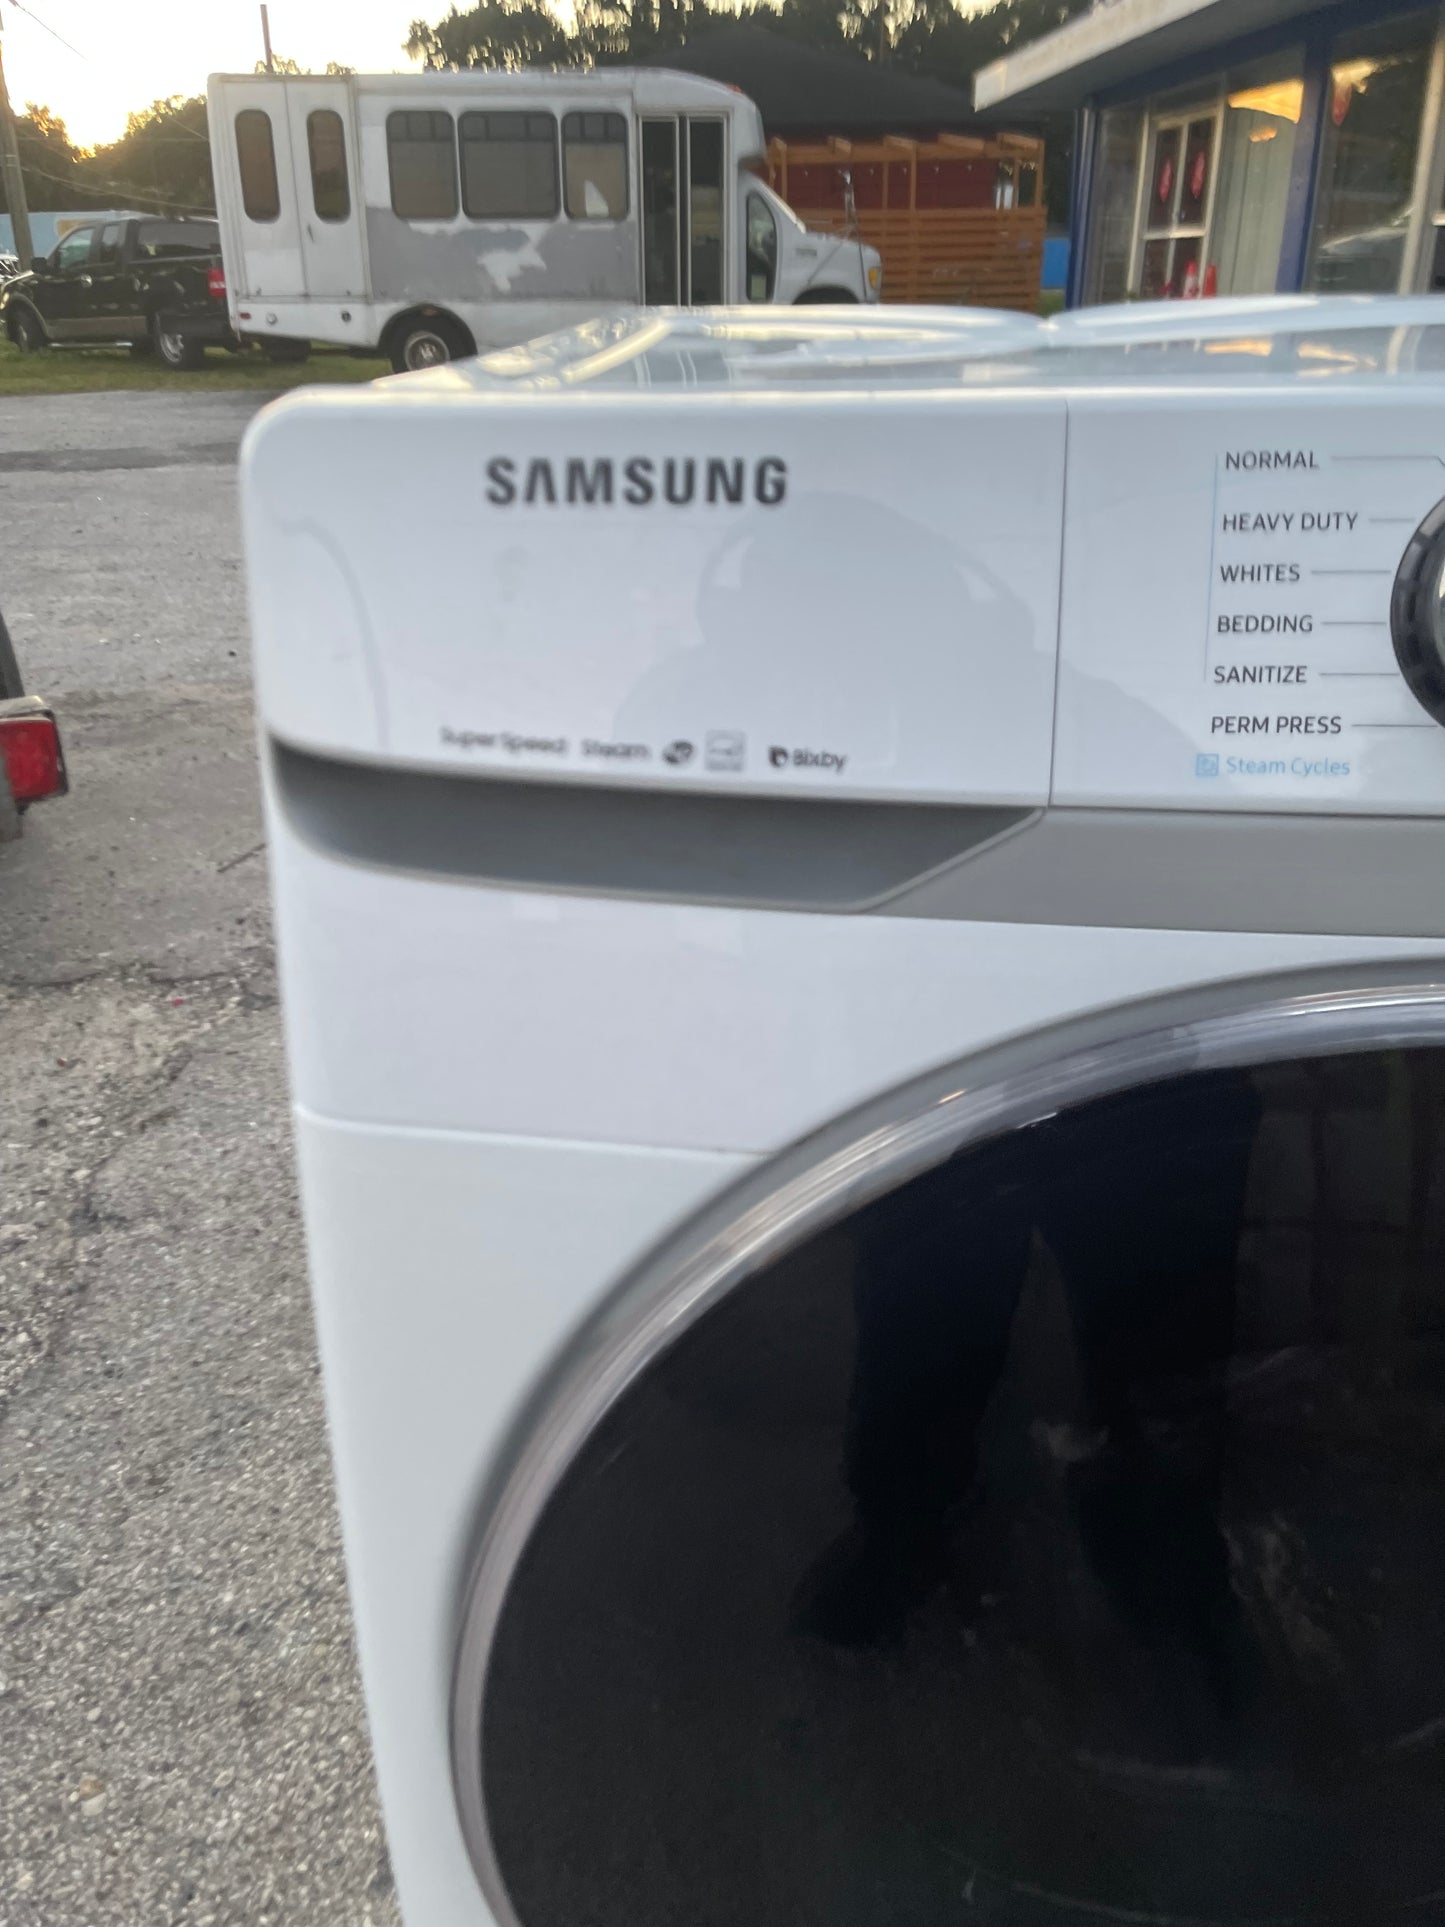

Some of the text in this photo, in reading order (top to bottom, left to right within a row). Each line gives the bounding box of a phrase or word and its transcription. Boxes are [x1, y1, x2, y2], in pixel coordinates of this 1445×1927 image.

[1226, 451, 1319, 470] NORMAL
[486, 456, 787, 506] SAMSUNG
[1222, 512, 1358, 532] HEAVY DUTY
[1220, 564, 1300, 582] WHITES
[1217, 615, 1313, 633] BEDDING
[1213, 665, 1308, 684] SANITIZE
[1211, 716, 1341, 734] PERM PRESS
[793, 748, 846, 773] Bixby
[1226, 756, 1350, 777] Steam Cycles
